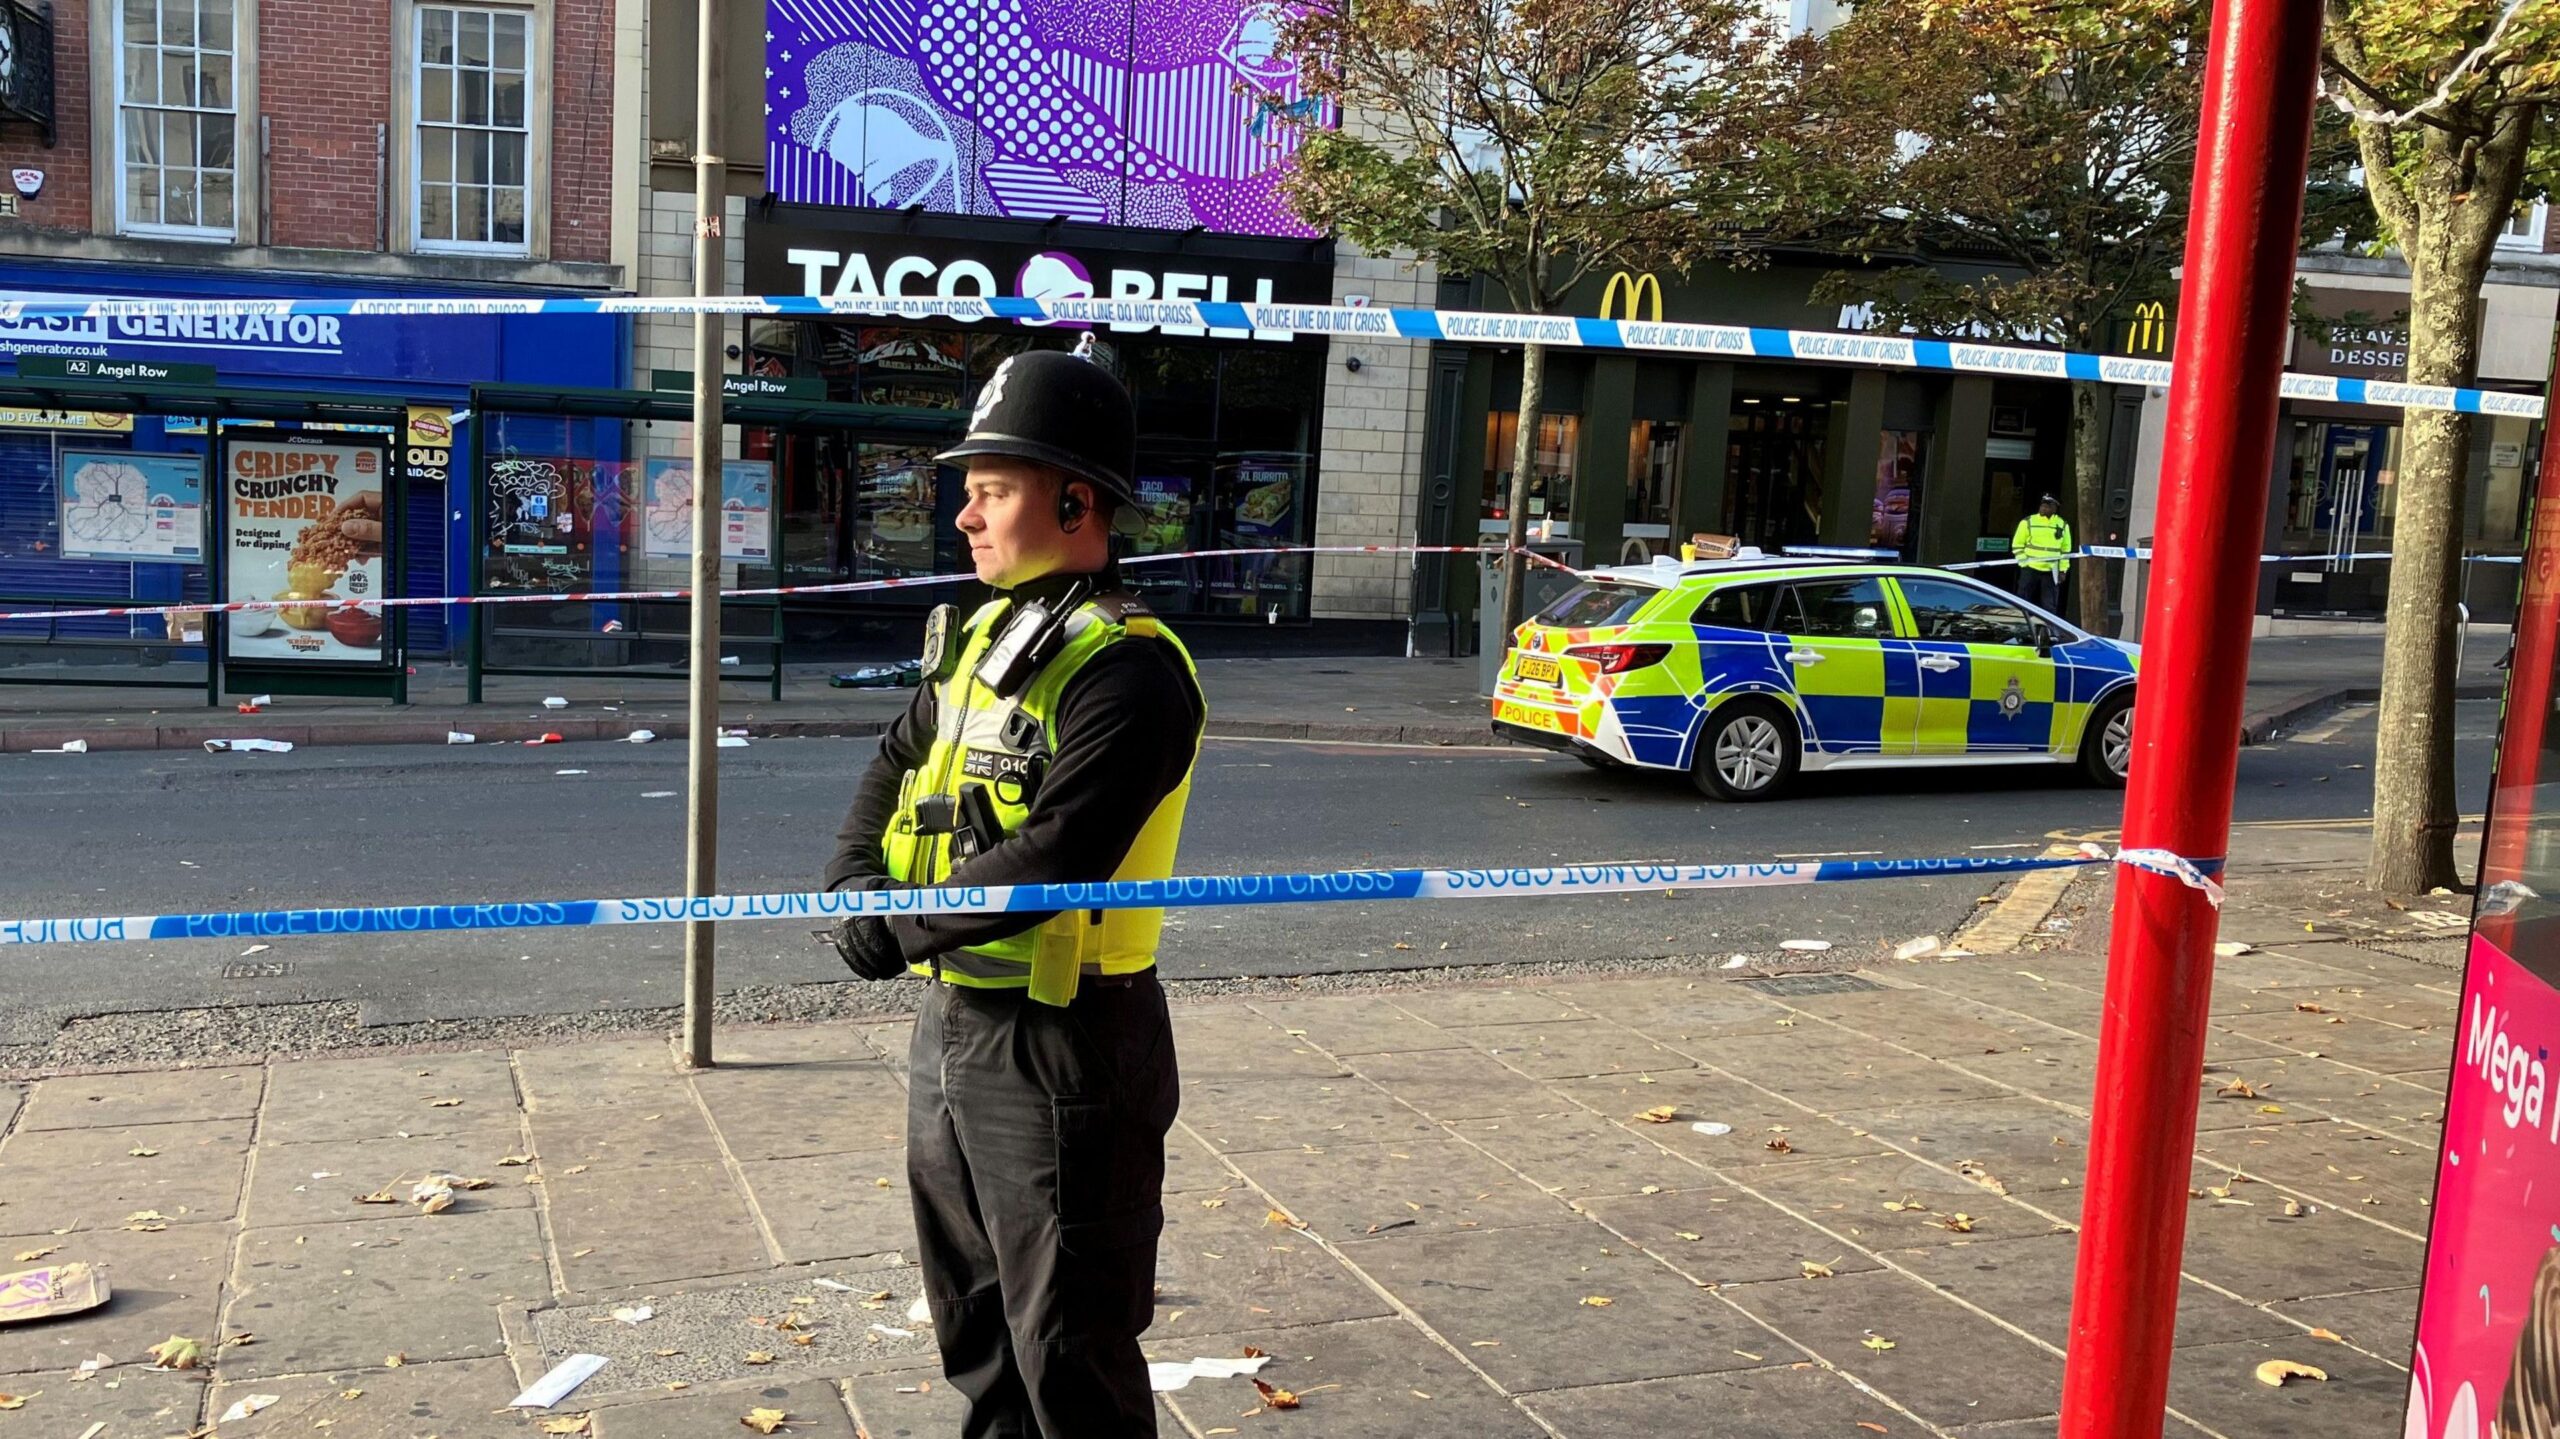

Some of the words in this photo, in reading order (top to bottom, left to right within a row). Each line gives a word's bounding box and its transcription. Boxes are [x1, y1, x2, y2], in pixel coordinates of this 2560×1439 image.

[787, 248, 996, 322] TACO
[1110, 269, 1294, 341] BELL
[1052, 302, 1089, 320] POLICE
[1091, 302, 1115, 321] LINE
[1117, 303, 1131, 321] DO
[1134, 304, 1155, 322] NOT
[1158, 304, 1192, 324] CROSS
[1256, 308, 1290, 329] POLICE
[1293, 310, 1314, 330] LINE
[1316, 311, 1330, 330] DO
[1333, 312, 1353, 331] NOT
[1354, 312, 1387, 333] CROSS
[117, 314, 342, 345] GENERATOR
[1446, 316, 1480, 336] POLICE
[1481, 318, 1501, 337] LINE
[1503, 319, 1517, 338] DO
[1519, 320, 1538, 339] NOT
[1539, 321, 1571, 340] CROSS
[1626, 326, 1659, 345] POLICE
[1659, 327, 1680, 346] LINE
[1680, 328, 1694, 347] DO
[1695, 330, 1714, 348] NOT
[1714, 331, 1745, 350] CROSS
[0, 340, 108, 356] shgenerator.co.uk
[1797, 336, 1827, 355] POLICE
[1827, 338, 1845, 356] LINE
[1846, 340, 1859, 357] DO
[1860, 341, 1880, 359] NOT
[1879, 343, 1909, 360] CROSS
[2330, 348, 2406, 367] DESSE
[70, 363, 86, 372] A2
[97, 364, 136, 378] Angel
[139, 365, 168, 377] Row
[1956, 348, 1985, 367] POLICE
[1983, 351, 2003, 367] LINE
[2002, 352, 2016, 368] DO
[2016, 354, 2034, 370] NOT
[2032, 355, 2061, 373] CROSS
[2104, 361, 2133, 378] POLICE
[2130, 363, 2149, 380] LINE
[724, 379, 758, 395] Angel
[761, 381, 787, 393] Row
[287, 436, 323, 444] JCDecaux
[234, 450, 340, 479] CRISPY
[391, 449, 448, 466] OLD
[406, 468, 423, 477] AID
[1240, 471, 1251, 481] XL
[234, 474, 339, 499] CRUNCHY
[1141, 481, 1163, 492] TACO
[235, 494, 336, 519] TENDER
[236, 529, 281, 539] Designed
[236, 539, 251, 548] for
[253, 539, 291, 551] dipping
[350, 573, 368, 583] 100%
[1505, 706, 1551, 729] POLICE
[874, 886, 985, 912] POLICE
[1043, 880, 1154, 904] POLICE
[1164, 877, 1209, 898] DO
[1217, 875, 1274, 897] NOT
[1285, 872, 1394, 894] CROSS
[621, 896, 732, 921] CROSS
[740, 893, 808, 917] NOT
[819, 891, 863, 912] DO
[3, 917, 124, 944] POLICE
[187, 911, 307, 938] POLICE
[316, 908, 363, 932] DO
[374, 905, 440, 930] NOT
[451, 902, 565, 928] CROSS
[2466, 992, 2545, 1131] Mega
